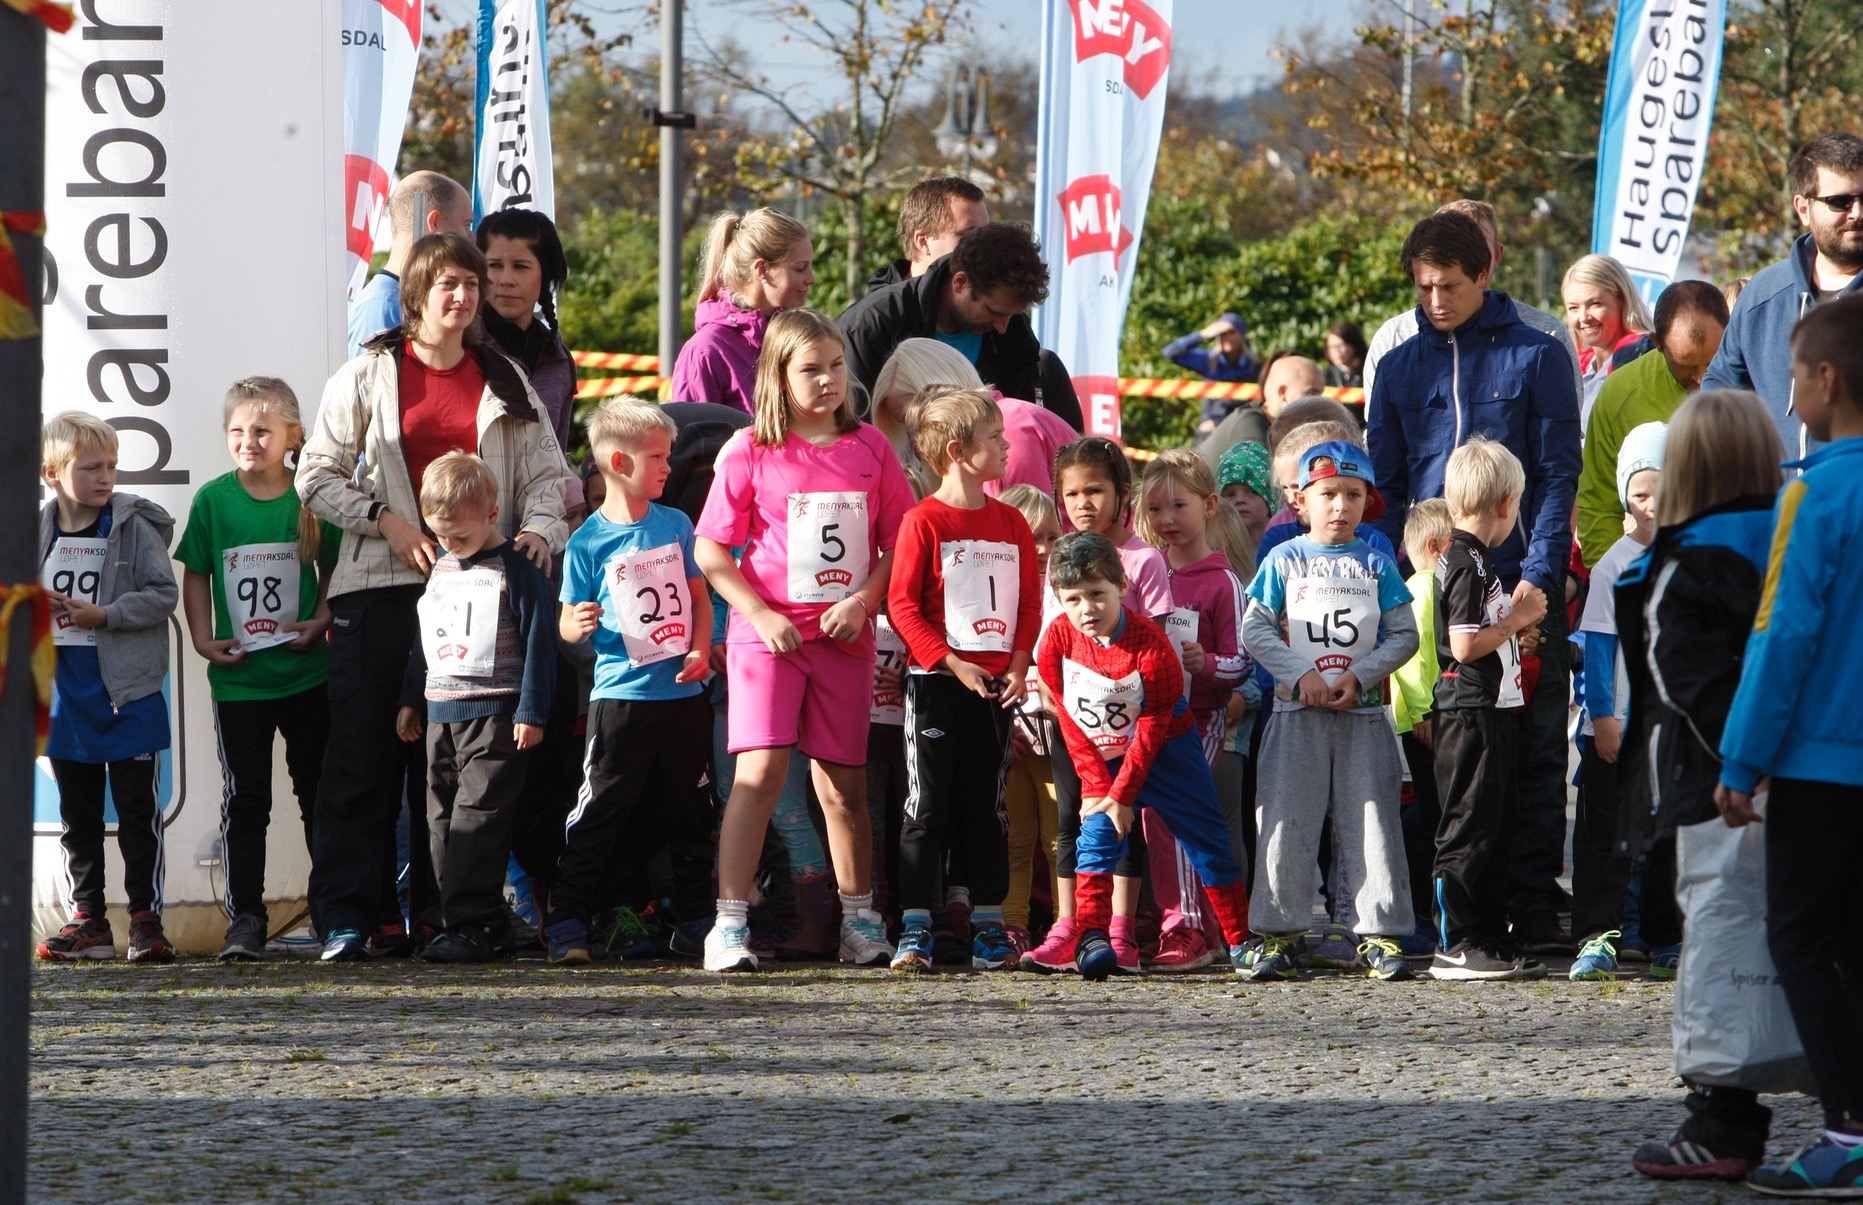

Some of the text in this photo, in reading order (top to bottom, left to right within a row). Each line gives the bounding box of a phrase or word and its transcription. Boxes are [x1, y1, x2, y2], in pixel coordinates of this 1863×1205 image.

[820, 523, 846, 563] 5
[243, 552, 295, 562] MENYAKSDAL
[634, 553, 680, 573] MENYAKSDAL
[973, 552, 1016, 563] MENYAKSDAL
[819, 572, 849, 582] MENY
[53, 570, 100, 604] 99
[988, 575, 997, 611] 1
[1316, 586, 1371, 597] MENYAKSDAL
[237, 576, 281, 618] 98
[636, 582, 682, 624] 23
[248, 622, 275, 631] MENY
[655, 626, 683, 640] MENY
[977, 621, 1005, 631] MENY
[1306, 608, 1359, 648] 45
[1319, 657, 1350, 668] MENY
[1078, 697, 1131, 731] 58
[1093, 737, 1125, 746] MENY
